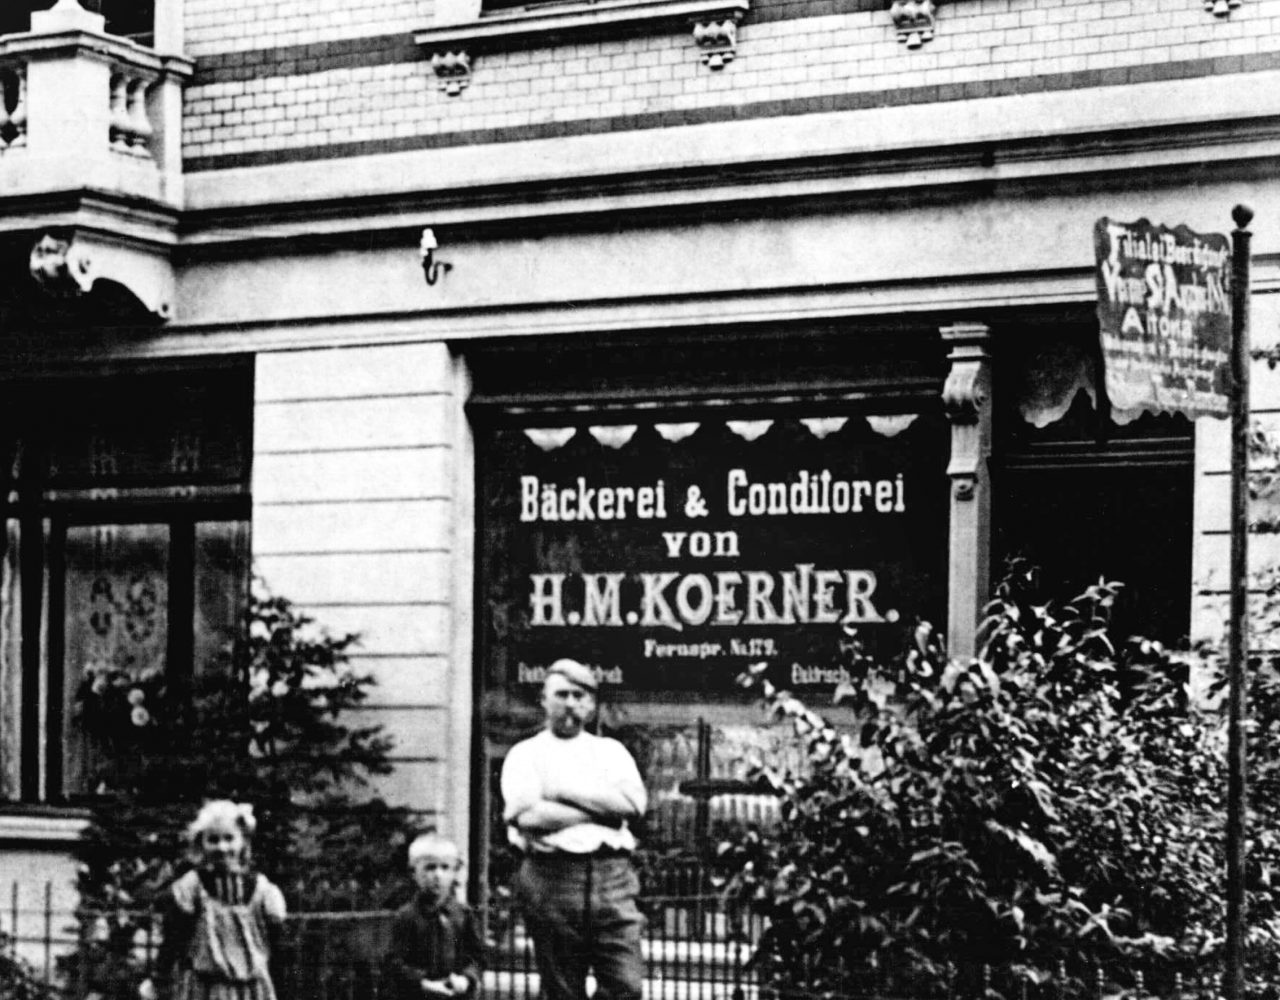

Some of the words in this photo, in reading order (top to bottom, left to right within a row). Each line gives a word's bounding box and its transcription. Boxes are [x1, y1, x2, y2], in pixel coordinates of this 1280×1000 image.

[520, 475, 666, 522] Bäckerei
[684, 484, 709, 518] &
[727, 469, 905, 516] Conditorei
[662, 531, 740, 557] von
